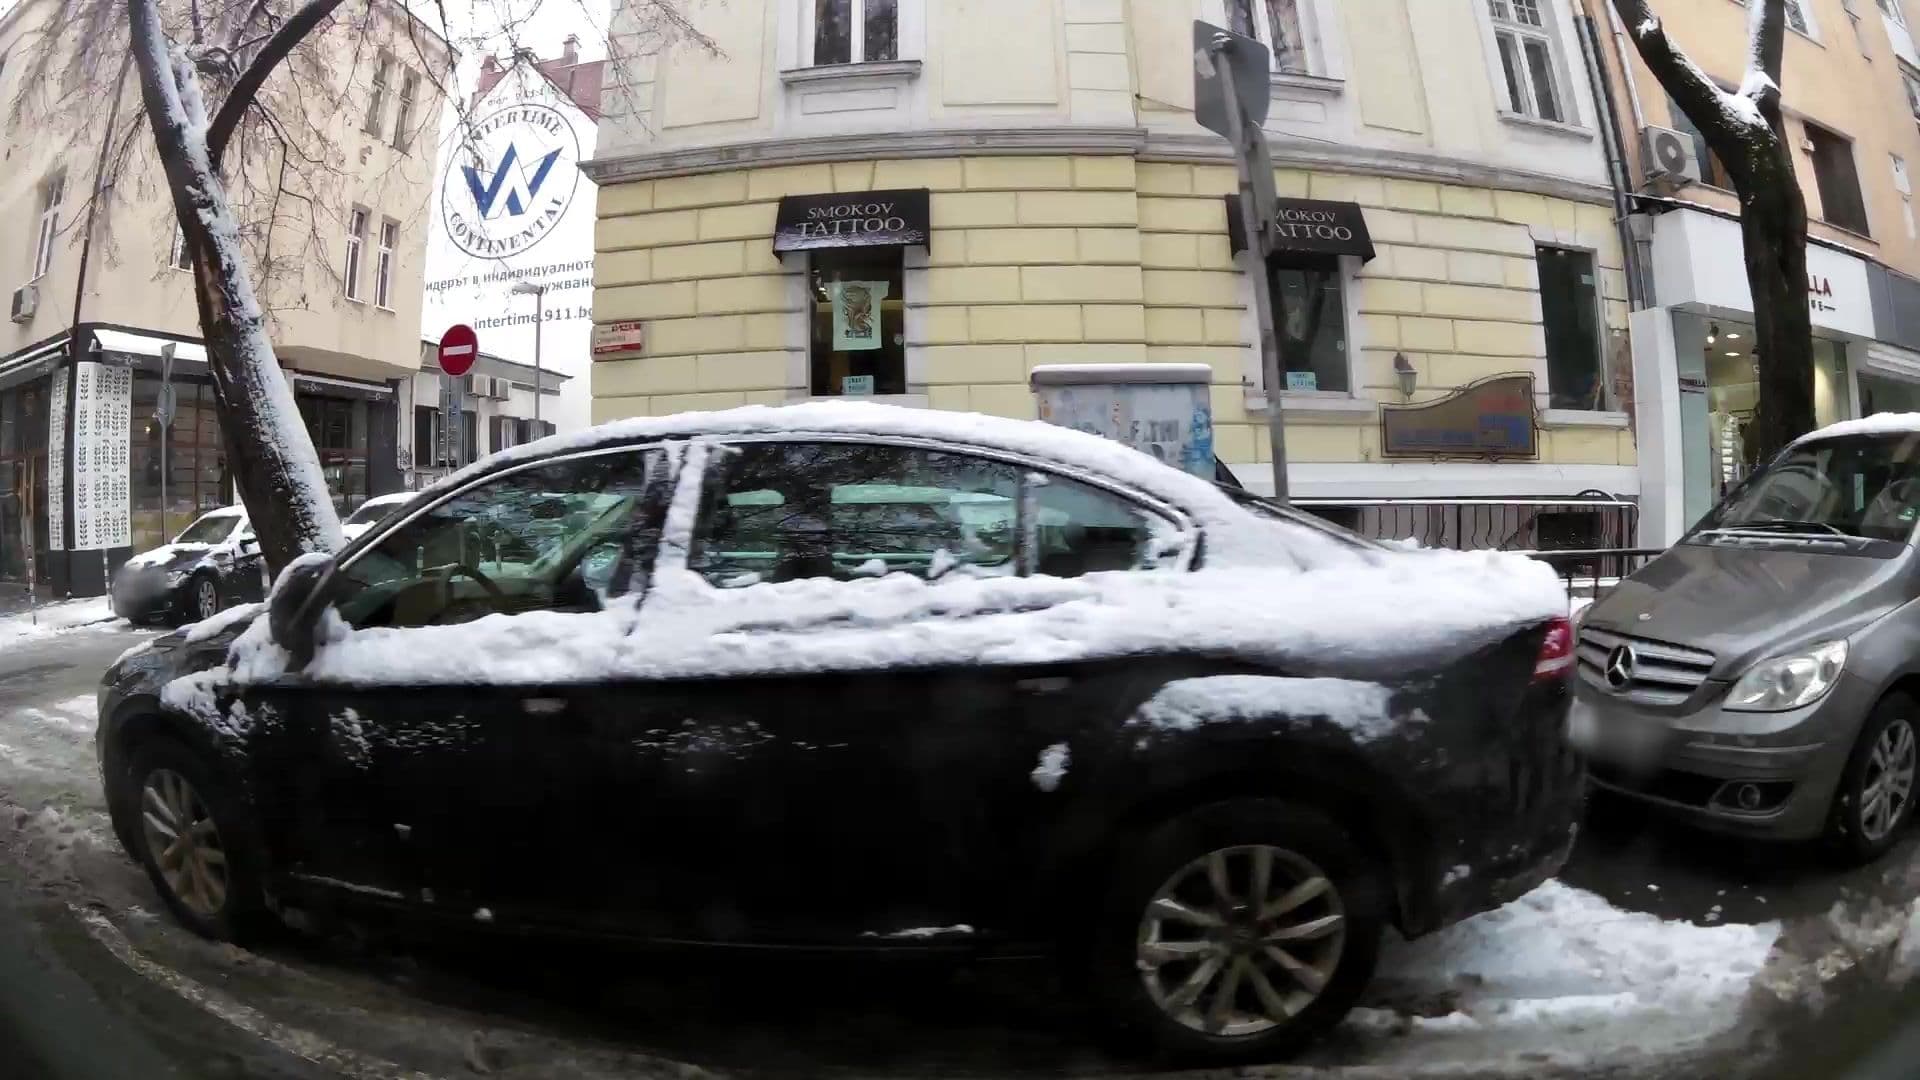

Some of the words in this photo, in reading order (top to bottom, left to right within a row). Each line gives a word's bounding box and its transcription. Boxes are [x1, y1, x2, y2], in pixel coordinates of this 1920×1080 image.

[469, 109, 564, 141] TERTIME
[807, 202, 895, 219] SMOKOV
[1275, 208, 1336, 223] MOKOV
[450, 194, 565, 254] CONTINENTAL
[795, 217, 905, 238] TATTOO
[1275, 222, 1353, 240] ATTOO
[425, 277, 468, 292] идерът
[472, 275, 479, 285] в
[483, 260, 593, 283] индивидуалнот
